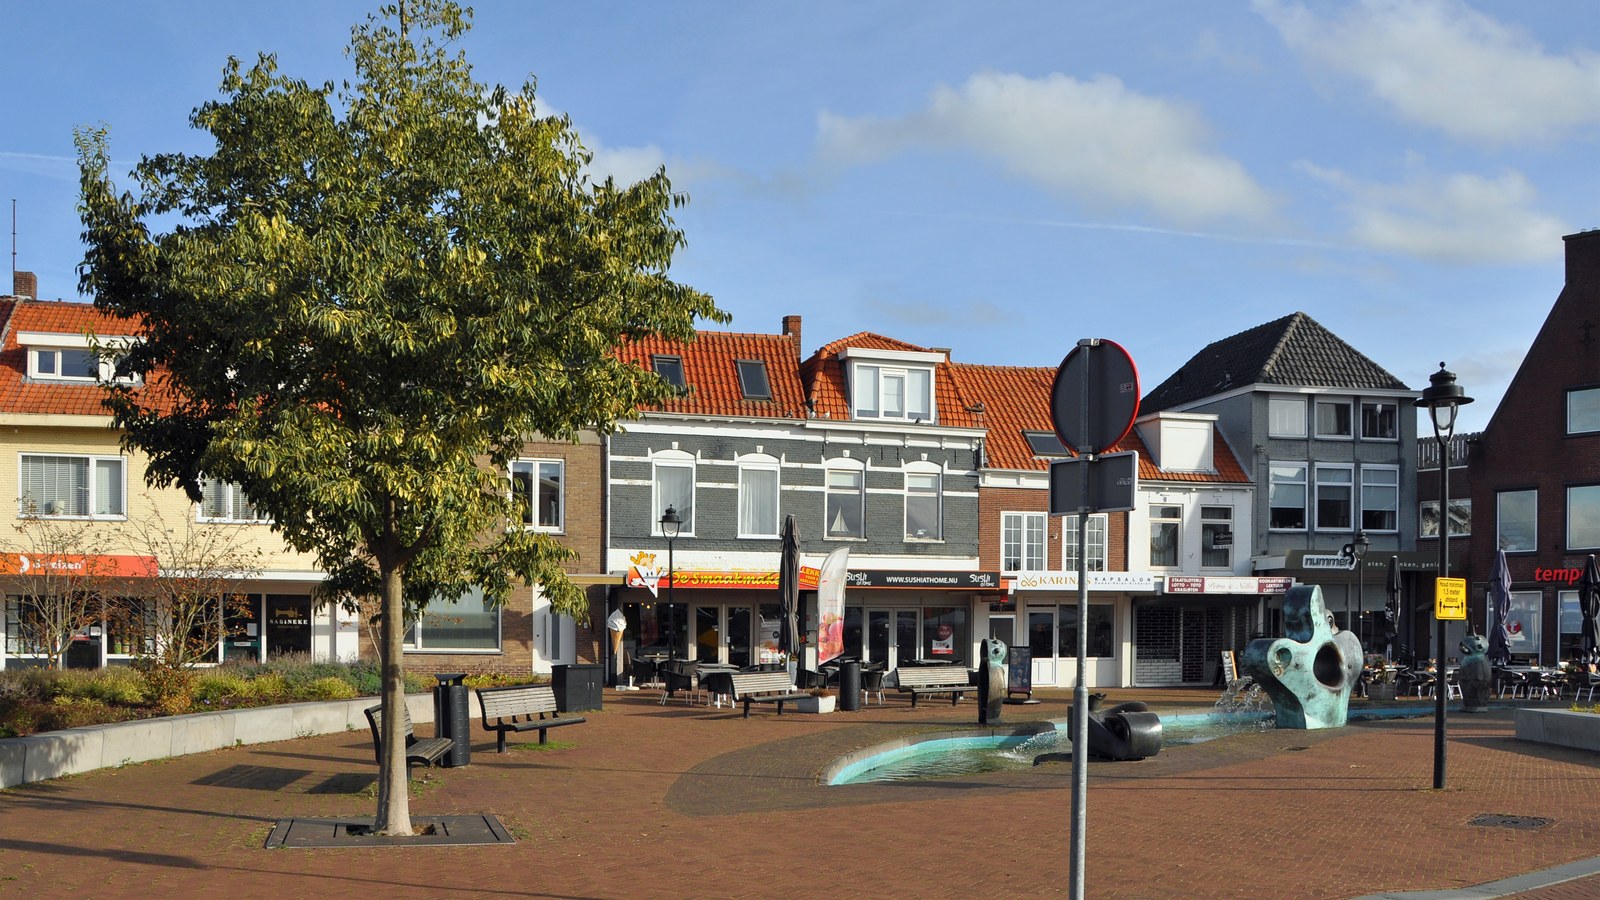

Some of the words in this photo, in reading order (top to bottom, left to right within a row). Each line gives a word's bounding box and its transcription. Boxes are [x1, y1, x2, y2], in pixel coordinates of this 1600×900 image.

[1304, 556, 1351, 567] nummer
[801, 566, 820, 577] LEKK
[1535, 567, 1584, 585] temp
[691, 571, 780, 585] Smaakmake
[886, 576, 958, 584] WWW.SUSHIATHOME.NU
[1040, 576, 1091, 585] KARINS
